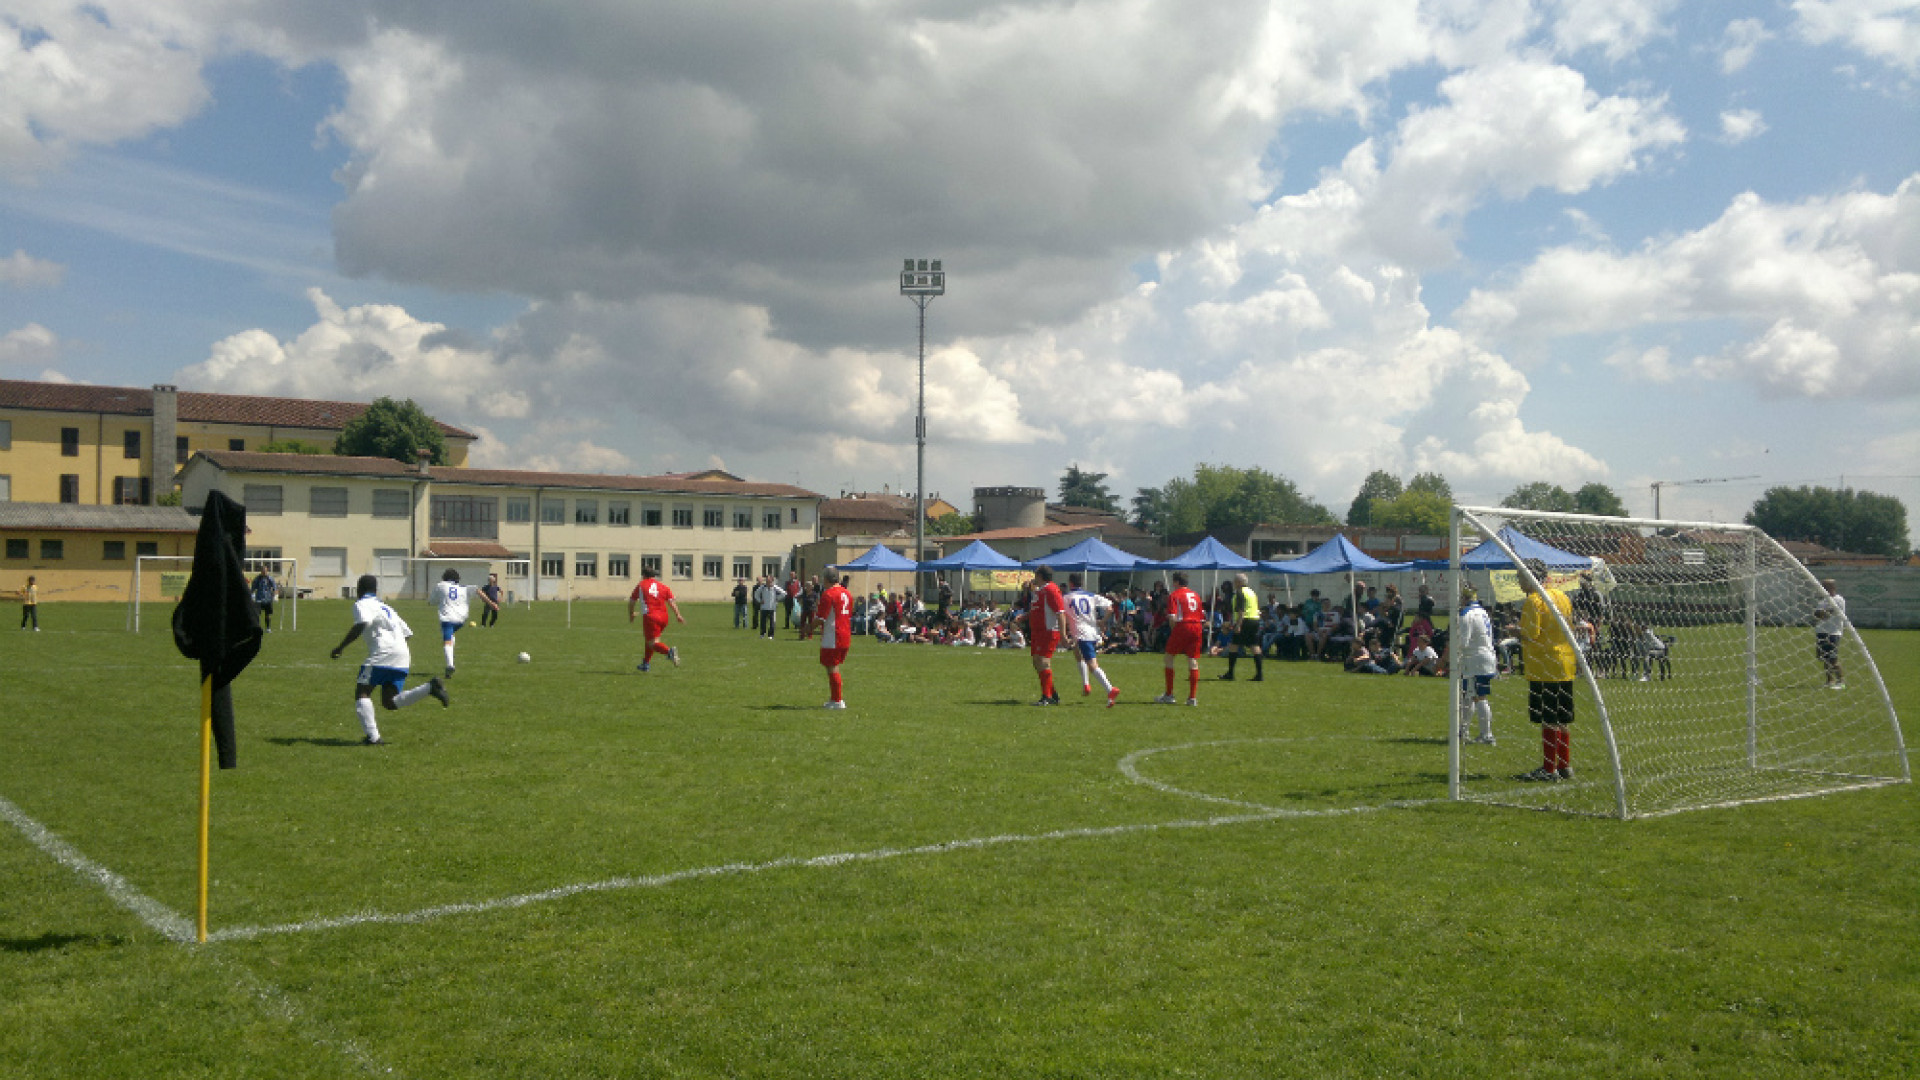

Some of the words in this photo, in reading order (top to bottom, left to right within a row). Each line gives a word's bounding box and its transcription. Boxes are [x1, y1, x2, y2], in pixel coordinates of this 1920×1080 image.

[449, 587, 457, 600] 8
[649, 583, 659, 598] 4
[841, 592, 849, 615] 2
[1069, 598, 1090, 615] 10
[1186, 593, 1198, 612] 5
